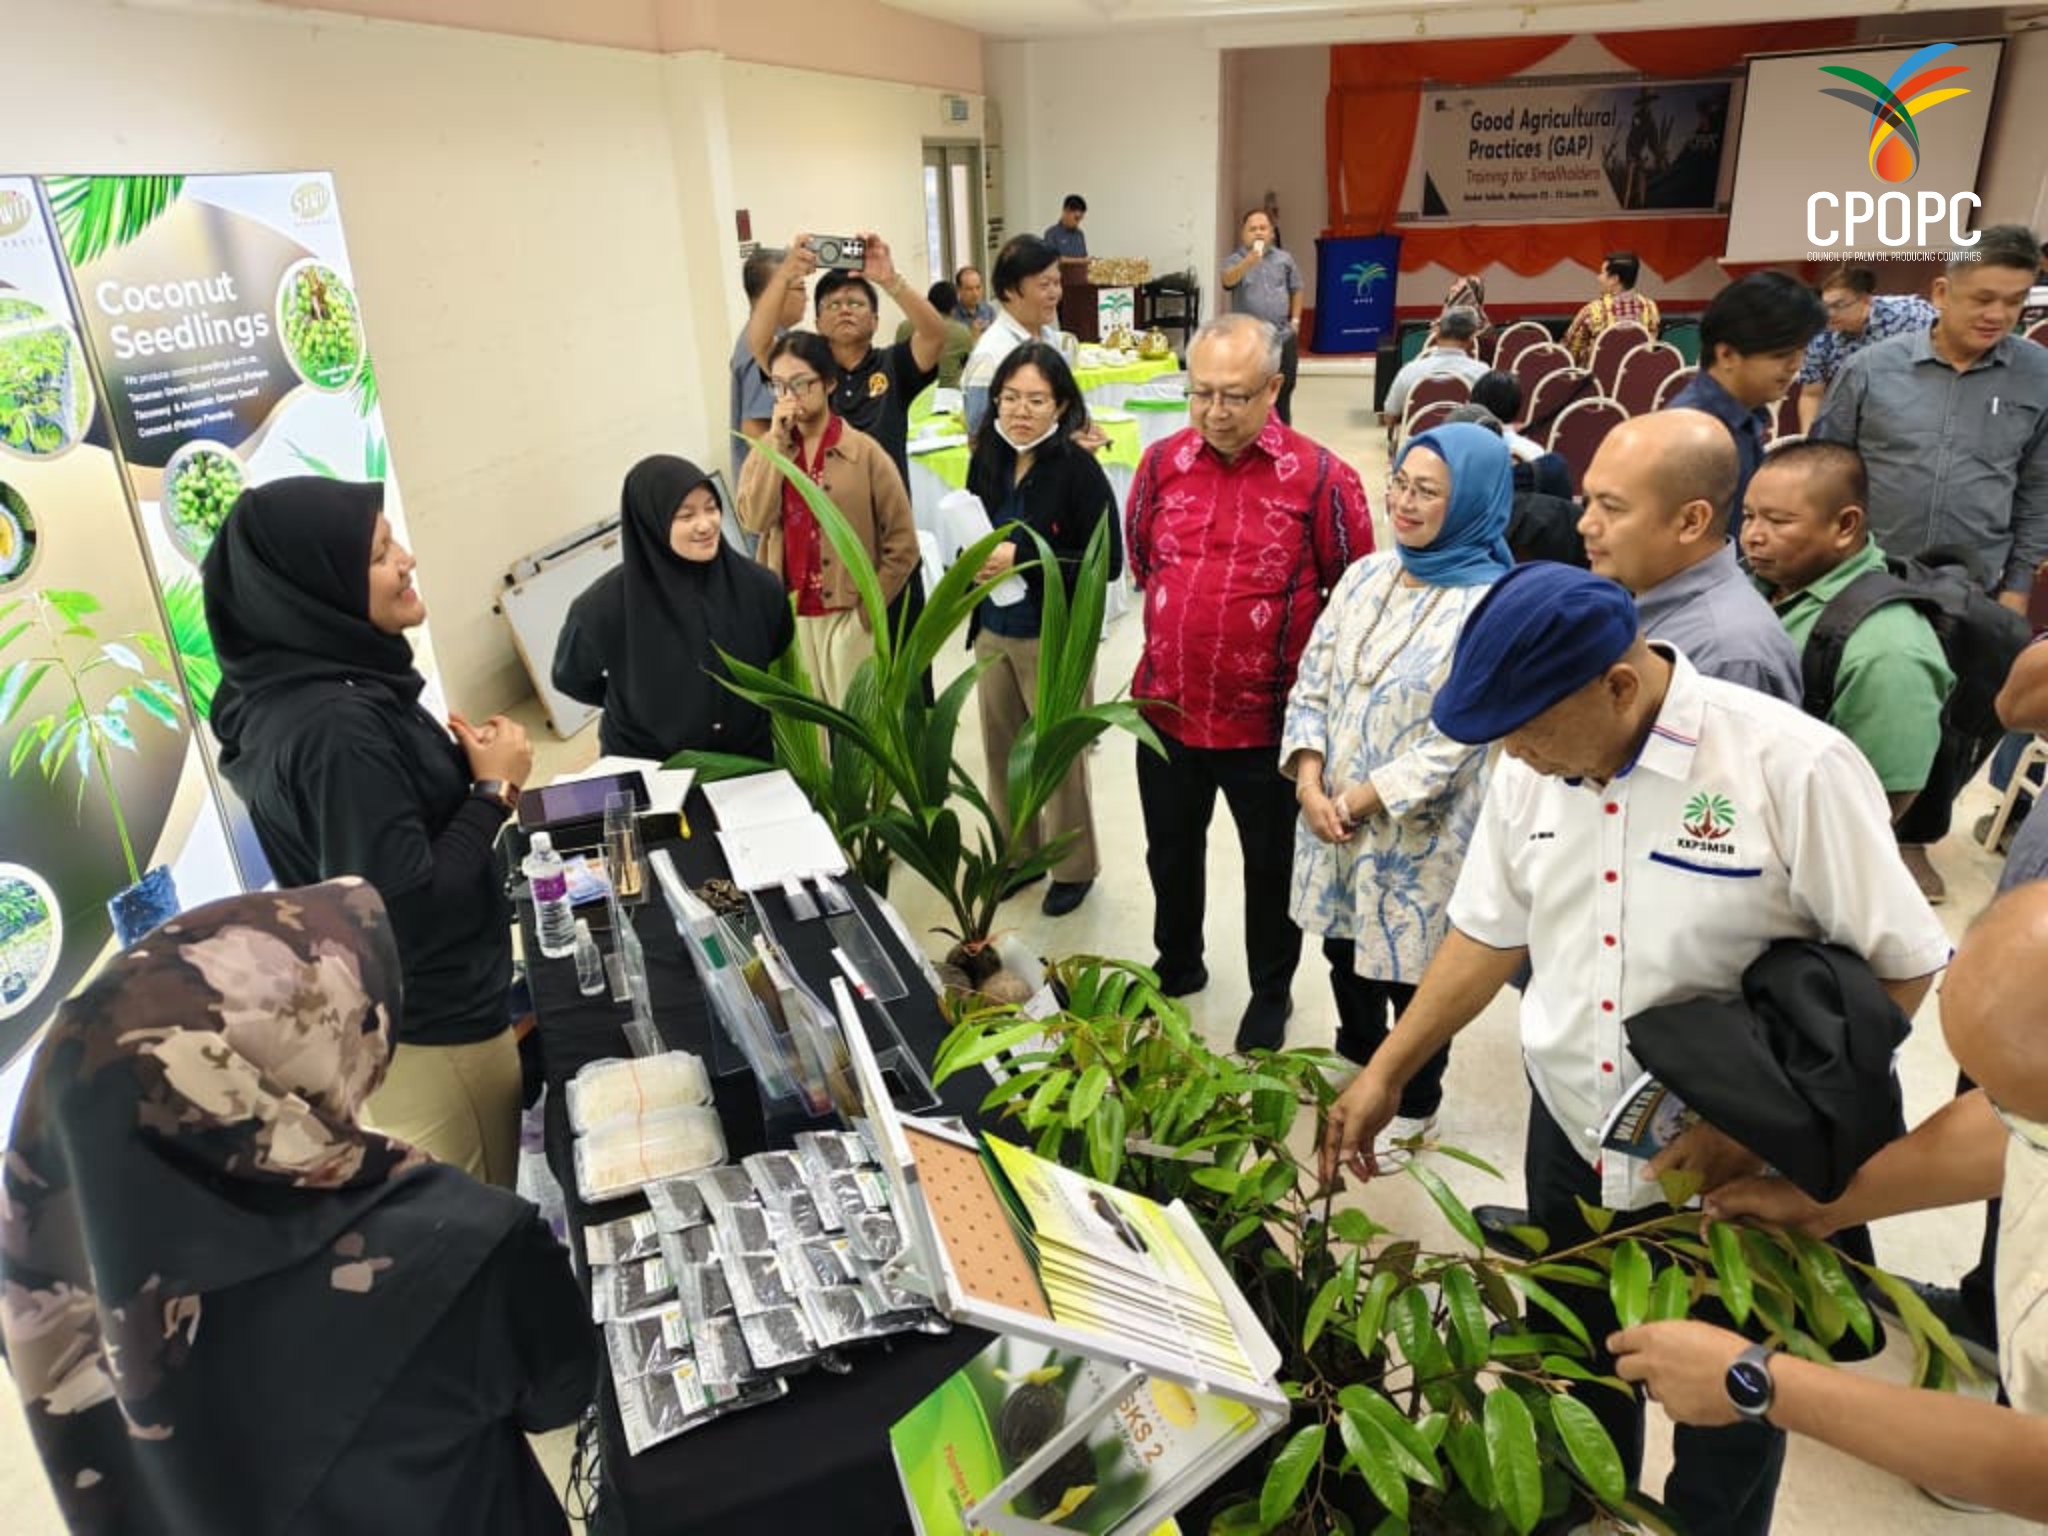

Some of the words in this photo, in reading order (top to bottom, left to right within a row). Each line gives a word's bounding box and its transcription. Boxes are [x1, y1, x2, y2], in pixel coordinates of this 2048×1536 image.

[1471, 107, 1514, 131] Good
[1519, 104, 1617, 134] Agricultural
[1469, 139, 1541, 160] Practices
[1548, 133, 1593, 160] (GAP)
[96, 271, 238, 316] Coconut
[110, 311, 269, 359] Seedlings
[1143, 1443, 1163, 1465] 2
